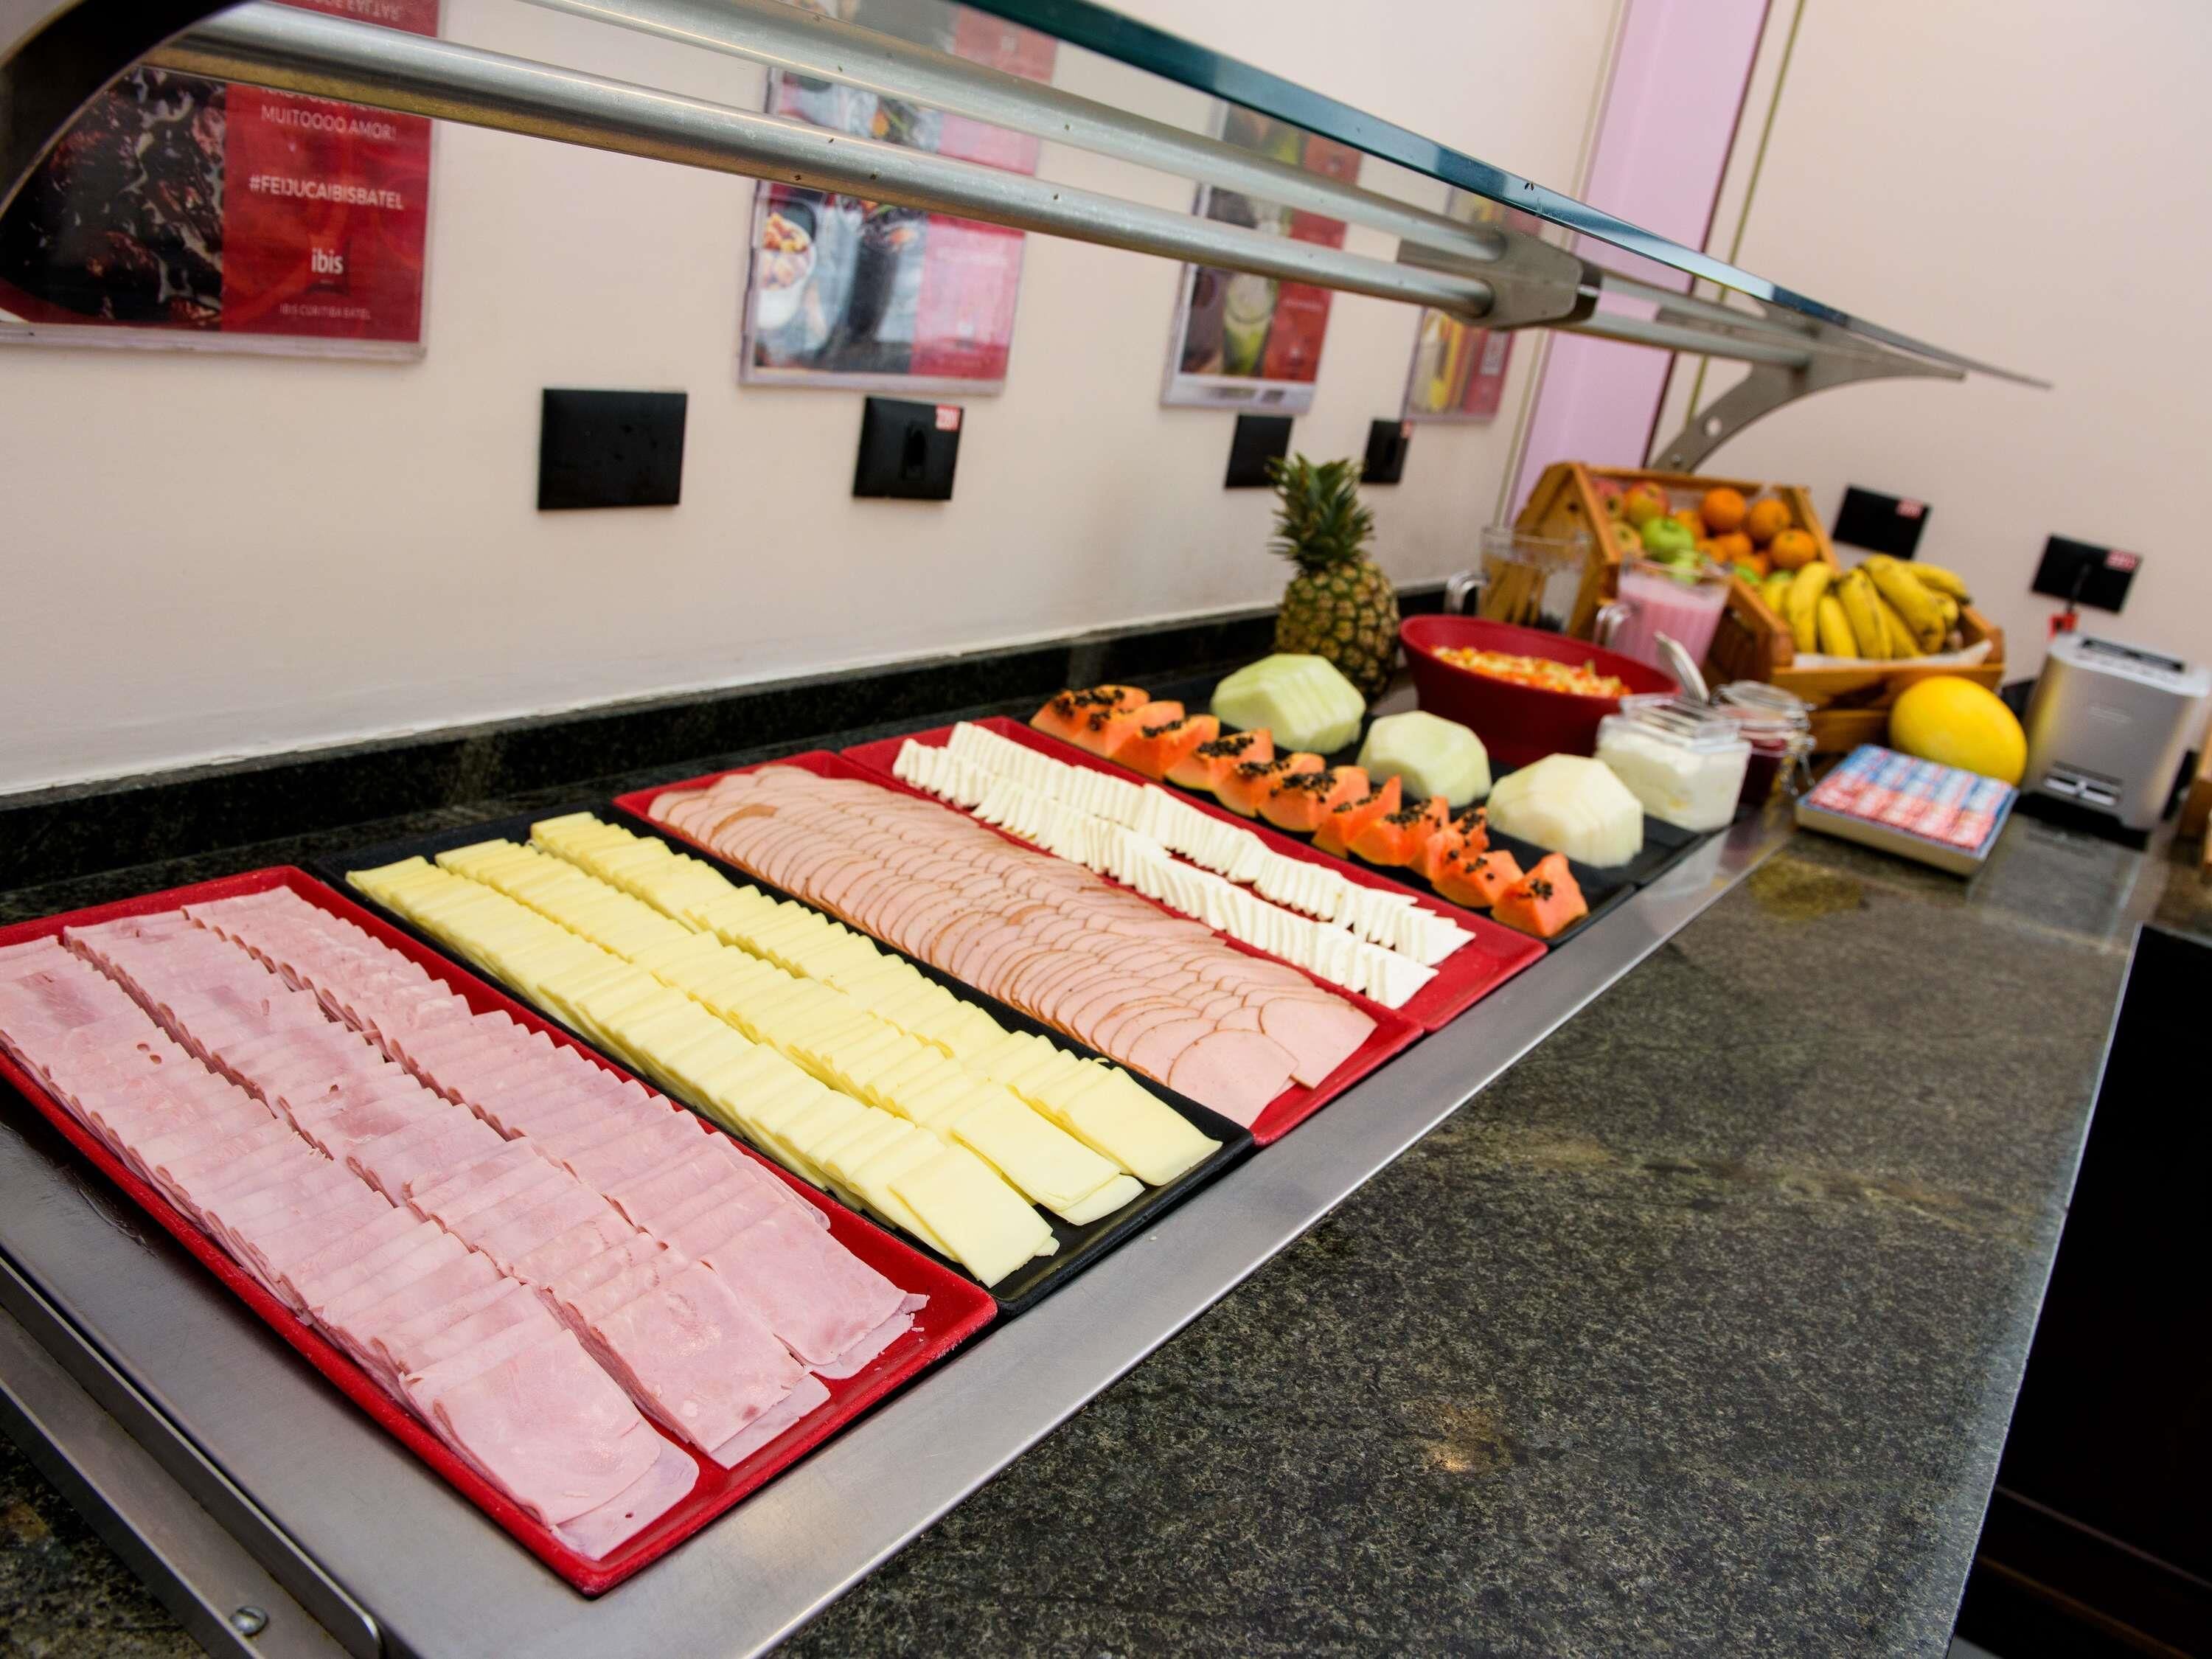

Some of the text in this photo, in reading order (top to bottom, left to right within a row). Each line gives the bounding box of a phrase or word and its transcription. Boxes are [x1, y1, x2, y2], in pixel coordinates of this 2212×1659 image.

[262, 105, 346, 133] MUITOOOO
[248, 175, 404, 209] #FEIJUCAIBISBATEL
[311, 248, 344, 274] ibis
